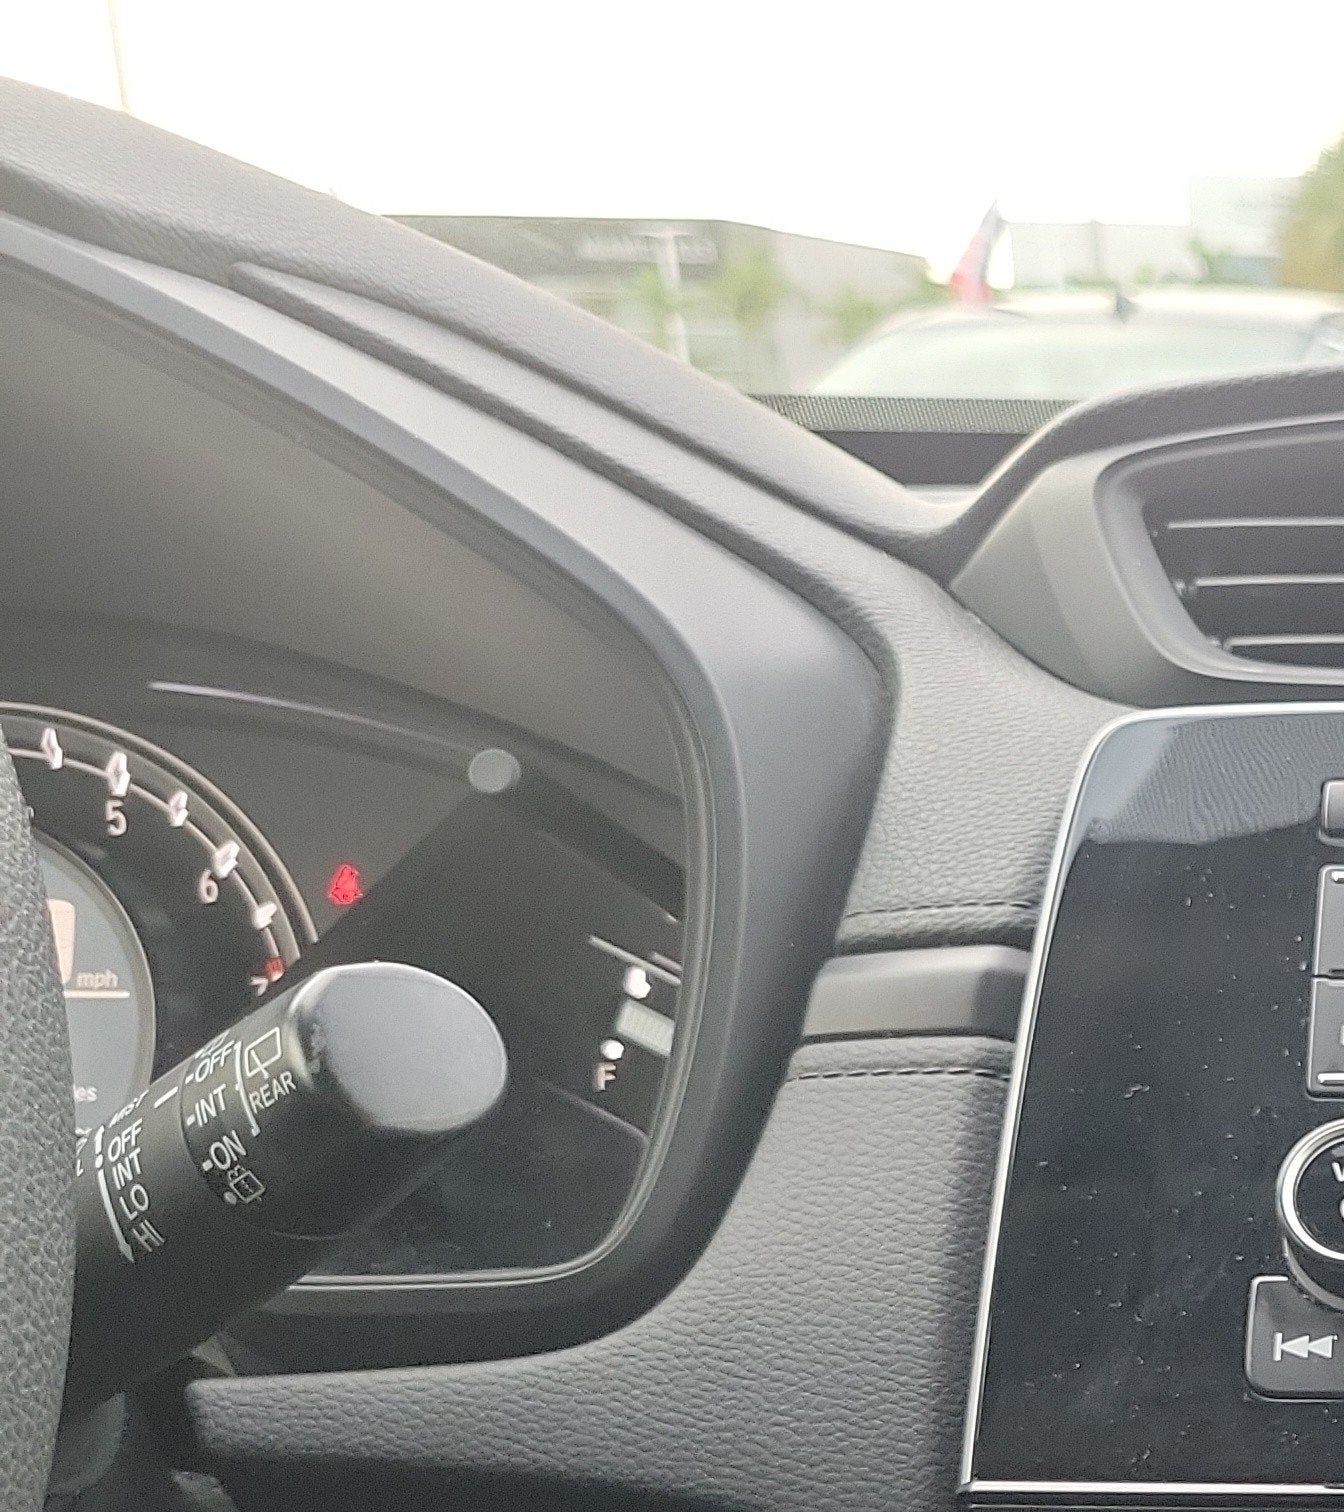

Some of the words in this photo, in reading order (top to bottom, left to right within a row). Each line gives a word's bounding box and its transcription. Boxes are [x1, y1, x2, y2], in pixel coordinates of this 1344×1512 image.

[106, 801, 127, 836] 5
[199, 870, 219, 903] 6
[76, 972, 119, 992] mph
[194, 1040, 237, 1083] OFF
[595, 1062, 617, 1091] F
[195, 1083, 227, 1127] INT
[249, 1070, 297, 1114] REAR
[107, 1118, 143, 1163] OFF
[209, 1130, 247, 1170] ON
[112, 1148, 142, 1190] INT
[119, 1183, 150, 1222] LO
[131, 1219, 166, 1253] HI
